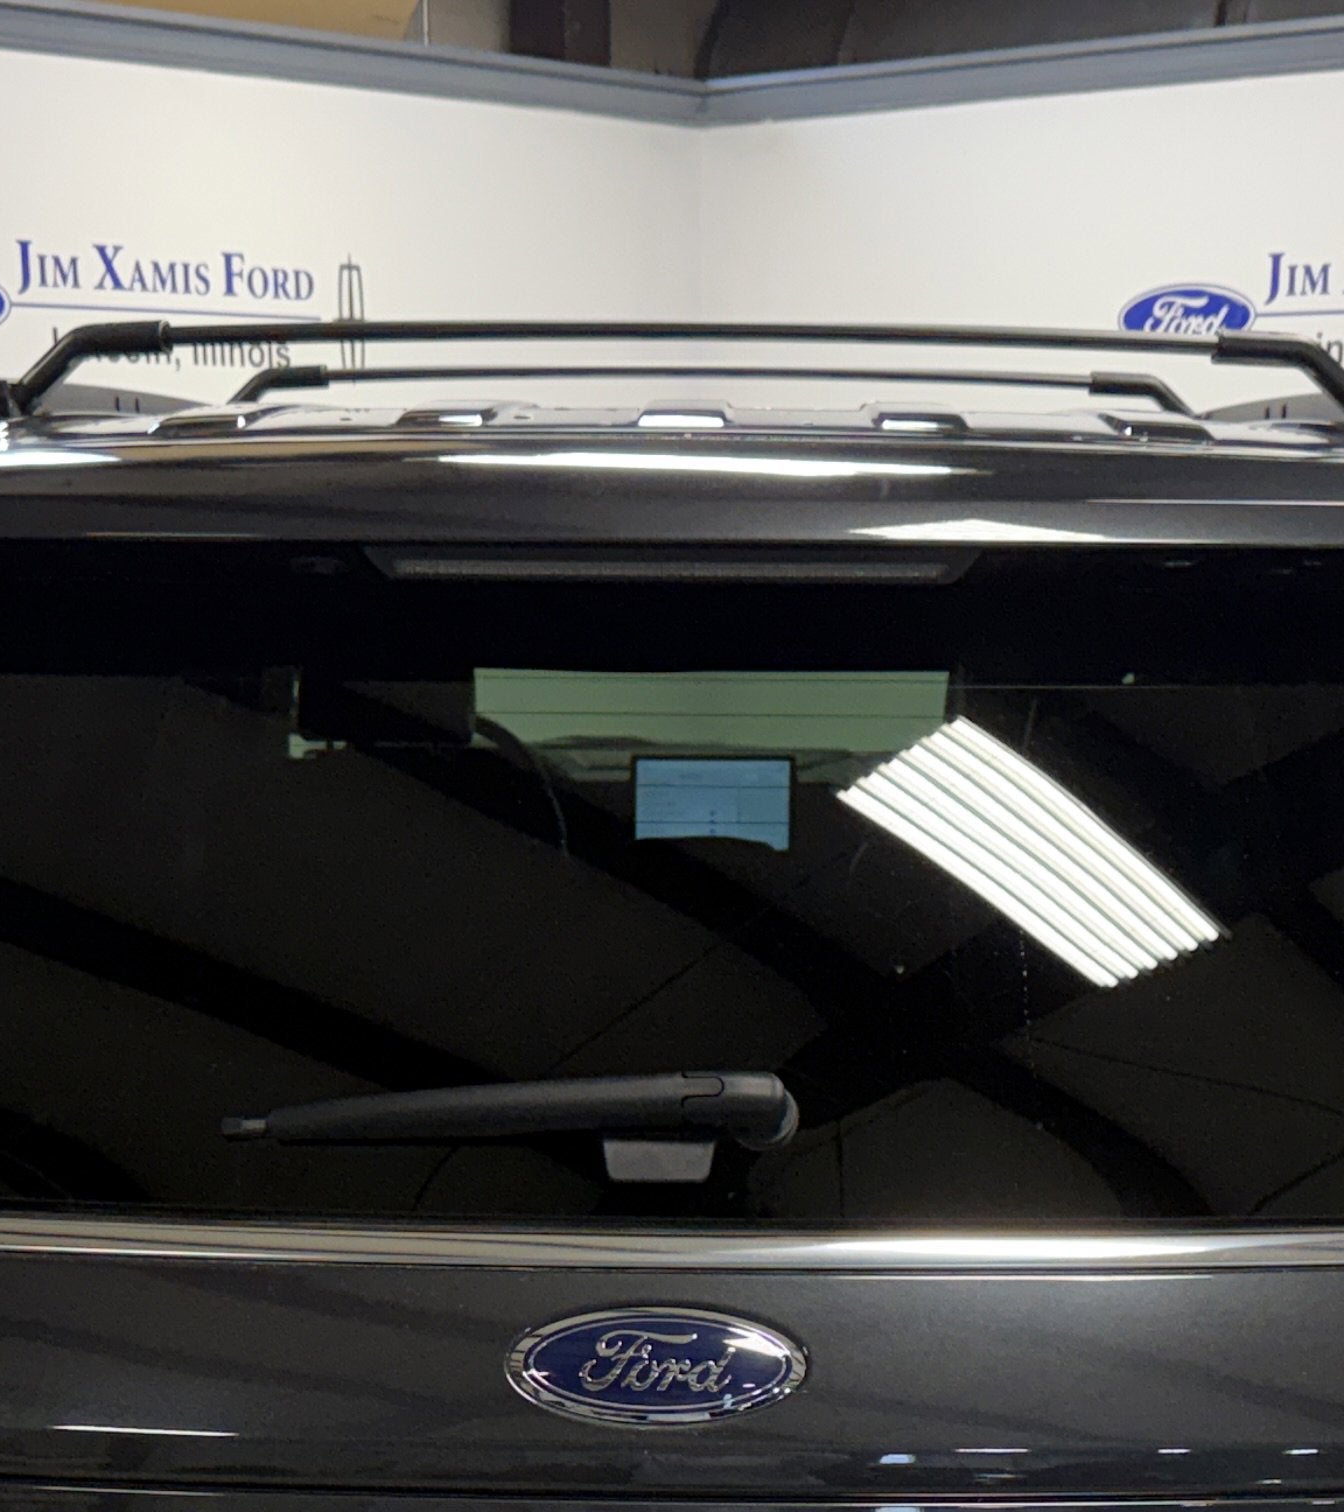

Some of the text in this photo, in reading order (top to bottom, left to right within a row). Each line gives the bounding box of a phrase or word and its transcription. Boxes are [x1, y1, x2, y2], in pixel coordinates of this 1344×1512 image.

[16, 239, 315, 301] JIM XAMIS FORD
[1265, 252, 1332, 305] JIM
[580, 1329, 736, 1392] Ford
